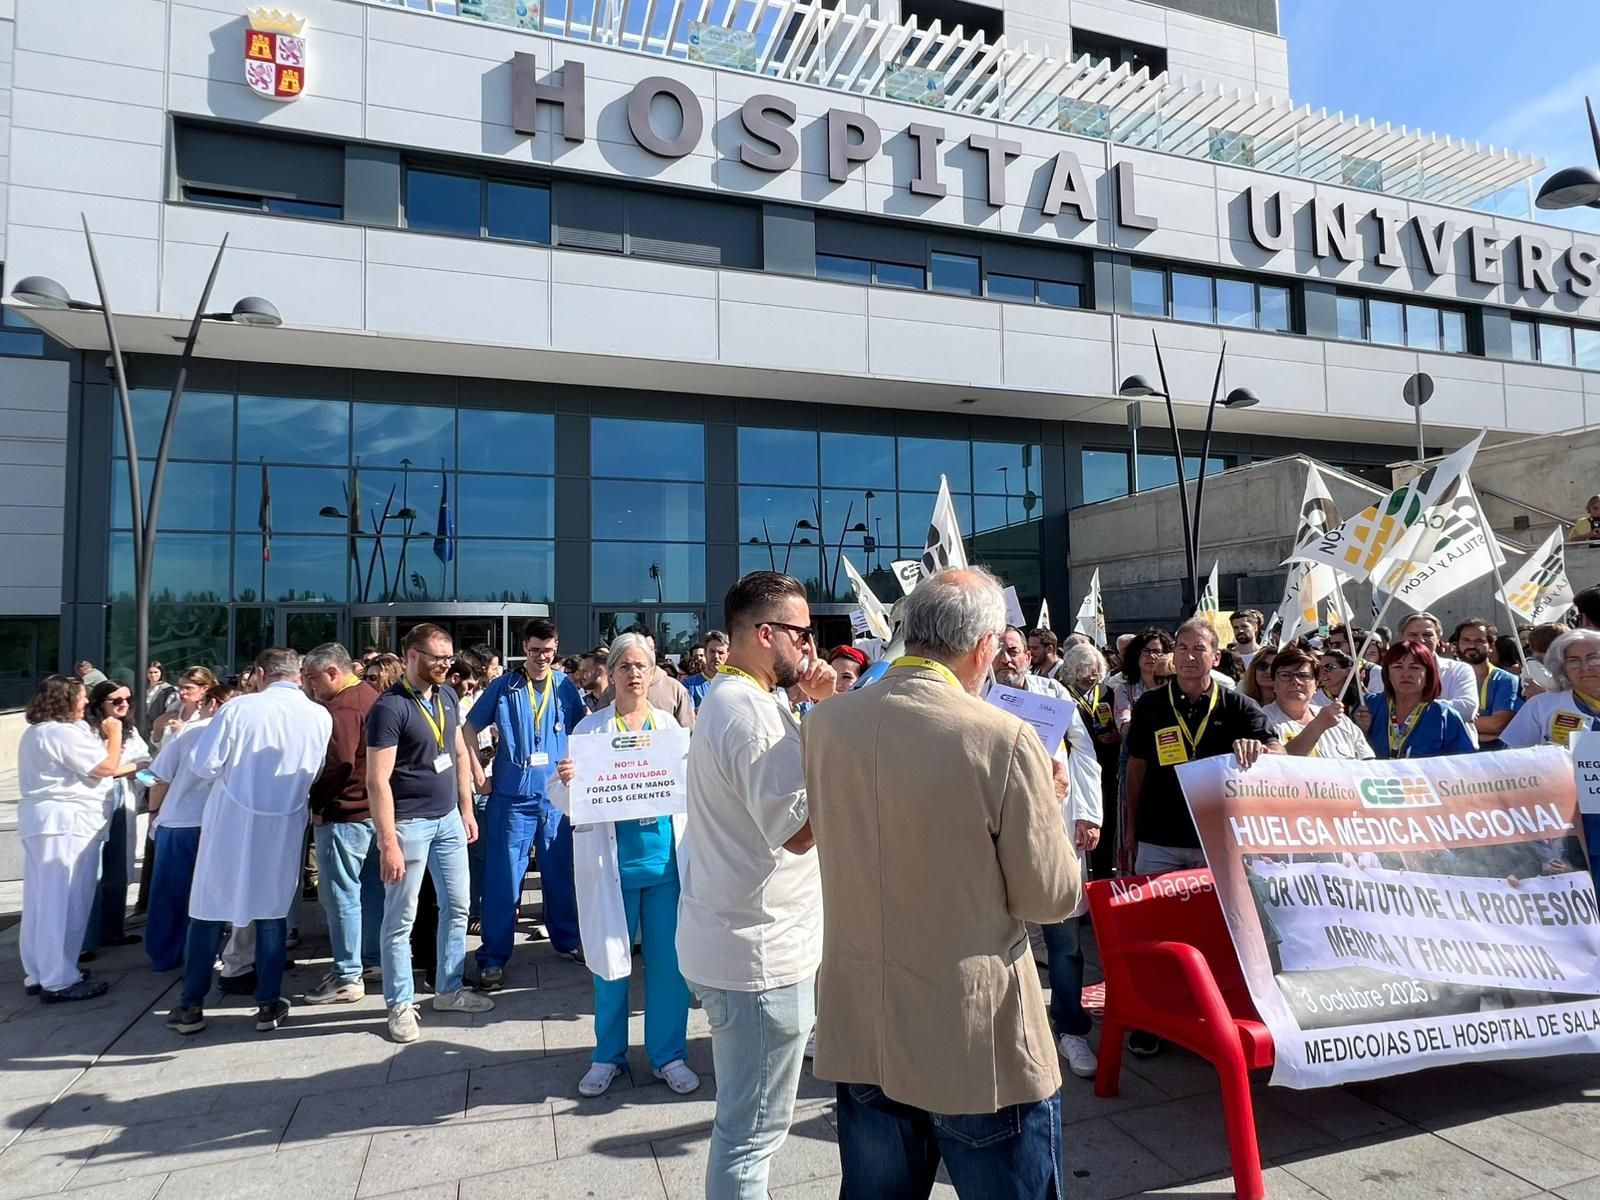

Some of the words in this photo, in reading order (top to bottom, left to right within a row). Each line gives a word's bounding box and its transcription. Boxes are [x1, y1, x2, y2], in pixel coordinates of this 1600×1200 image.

[513, 51, 1158, 231] HOSPITAL
[1247, 185, 1600, 297] UNIVERS
[586, 784, 629, 794] FORZOSA
[631, 782, 643, 790] EN
[645, 779, 676, 788] MANOS
[620, 769, 667, 780] MOVILIDAD
[1224, 779, 1300, 799] Sindicato
[1304, 781, 1356, 800] Médico
[1438, 775, 1540, 798] Salamanca
[606, 795, 623, 803] LOS
[625, 790, 671, 801] GERENTES
[1229, 815, 1336, 847] HUELGA
[1332, 810, 1430, 846] MÉDICA
[1425, 803, 1575, 843] NACIONAL
[1109, 879, 1143, 904] No
[1146, 872, 1213, 902] hagas
[1292, 874, 1324, 906] UN
[1321, 874, 1415, 918] ESTATUTO
[1413, 886, 1449, 920] DE
[1445, 889, 1481, 923] LA
[1324, 917, 1397, 968] MÉDICA
[1394, 935, 1417, 969] Y
[1414, 937, 1566, 981] FACULTATIVA
[1301, 990, 1318, 1013] 3
[1320, 986, 1386, 1012] octubre
[1382, 980, 1429, 1006] 2025
[1304, 1031, 1412, 1065] MEDICO/AS
[1413, 1027, 1452, 1053] DEL
[1452, 1017, 1535, 1048] HOSPITAL
[1536, 1014, 1561, 1037] DE
